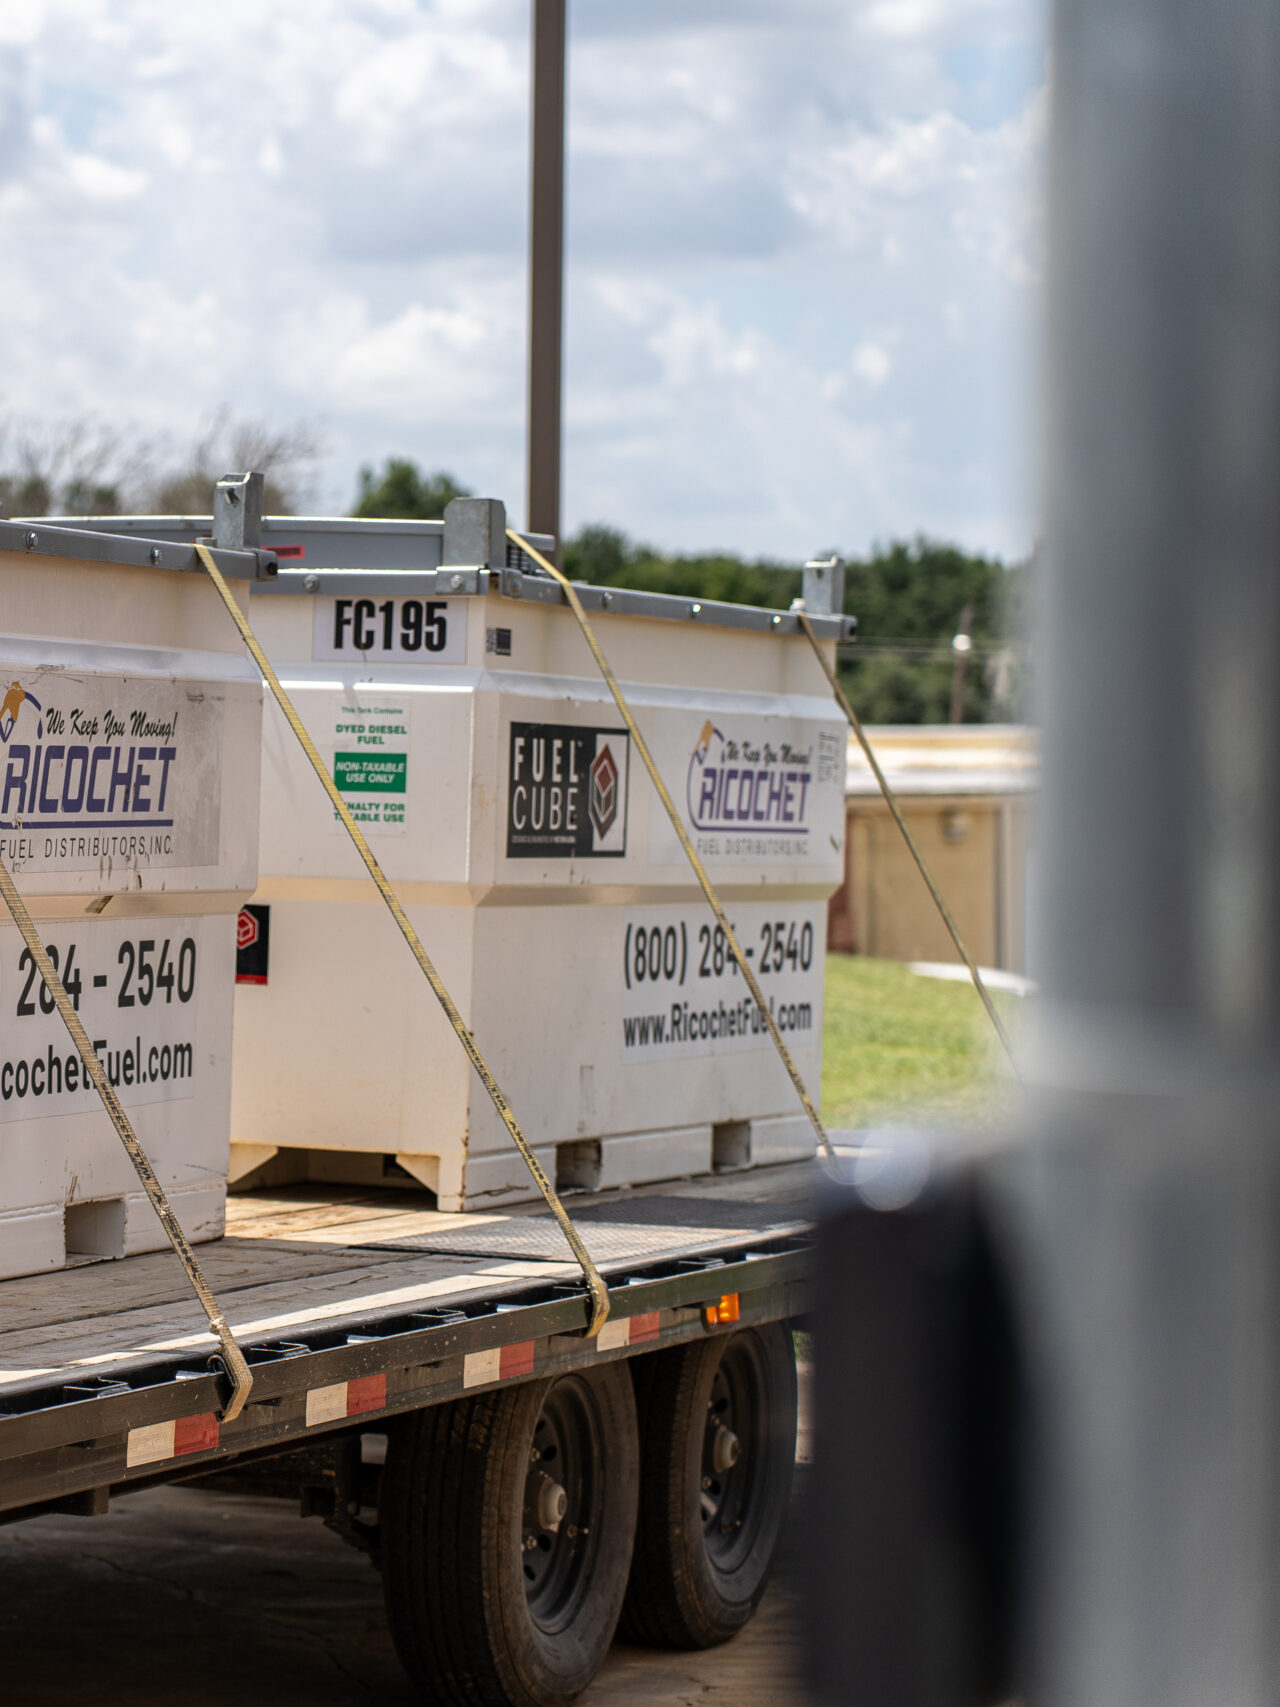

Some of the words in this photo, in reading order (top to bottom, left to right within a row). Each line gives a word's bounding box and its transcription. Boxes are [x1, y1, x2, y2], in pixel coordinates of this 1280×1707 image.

[333, 599, 448, 652] FC195
[46, 707, 65, 735] We
[70, 708, 99, 743] Keep
[104, 709, 125, 744] You
[130, 710, 178, 745] Moving!
[336, 724, 366, 734] DYED
[368, 725, 407, 735] DIESEL
[357, 736, 385, 745] FUEL
[1, 745, 177, 814] RICOCHET
[336, 761, 405, 773] NON-TAXABLE
[346, 773, 366, 782] USE
[368, 773, 395, 783] ONLY
[514, 737, 579, 783] FUEL
[335, 802, 381, 811] NALTY
[384, 803, 406, 812] FOR
[513, 785, 578, 830] CUBE
[698, 768, 811, 822] RICOCHET
[334, 813, 380, 822] TABLE
[383, 814, 406, 823] USE
[0, 838, 34, 859] FUEL
[118, 937, 197, 1009] 2540
[625, 921, 688, 990] (800)
[760, 921, 813, 974] 2540
[623, 997, 811, 1048] www.RicochetFuelcom
[152, 1189, 193, 1265] HUSY
